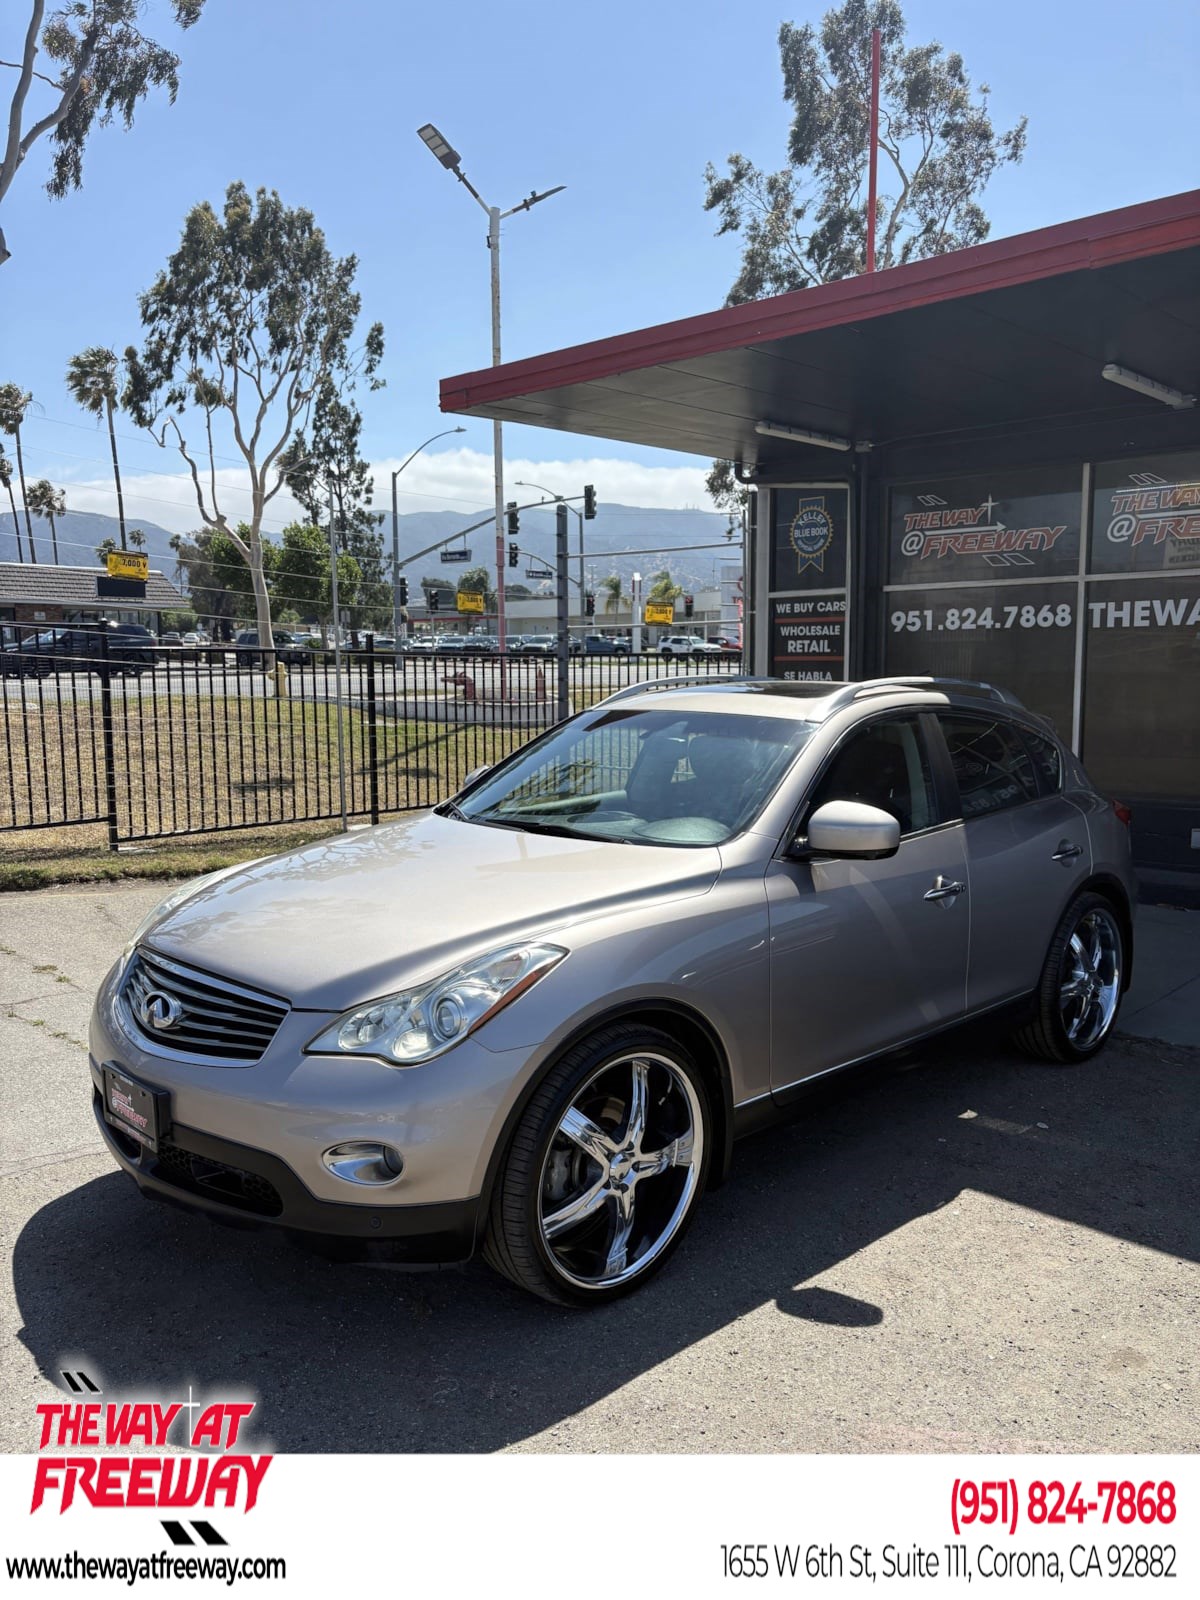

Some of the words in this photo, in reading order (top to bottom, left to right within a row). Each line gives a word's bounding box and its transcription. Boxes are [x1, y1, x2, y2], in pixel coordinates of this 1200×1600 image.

[1111, 492, 1160, 516] THE
[797, 511, 826, 527] KELLEY
[903, 511, 941, 531] THE
[942, 507, 987, 528] WAY
[794, 529, 811, 538] BLUE
[811, 527, 829, 537] BOOK
[776, 603, 791, 613] WE
[794, 602, 814, 613] BUY
[817, 601, 847, 612] CARS
[890, 603, 1072, 632] 951.824.7868
[780, 625, 840, 636] WHOLESALE
[787, 640, 831, 653] RETAIL
[783, 671, 795, 681] SE
[798, 671, 832, 681] HABLA
